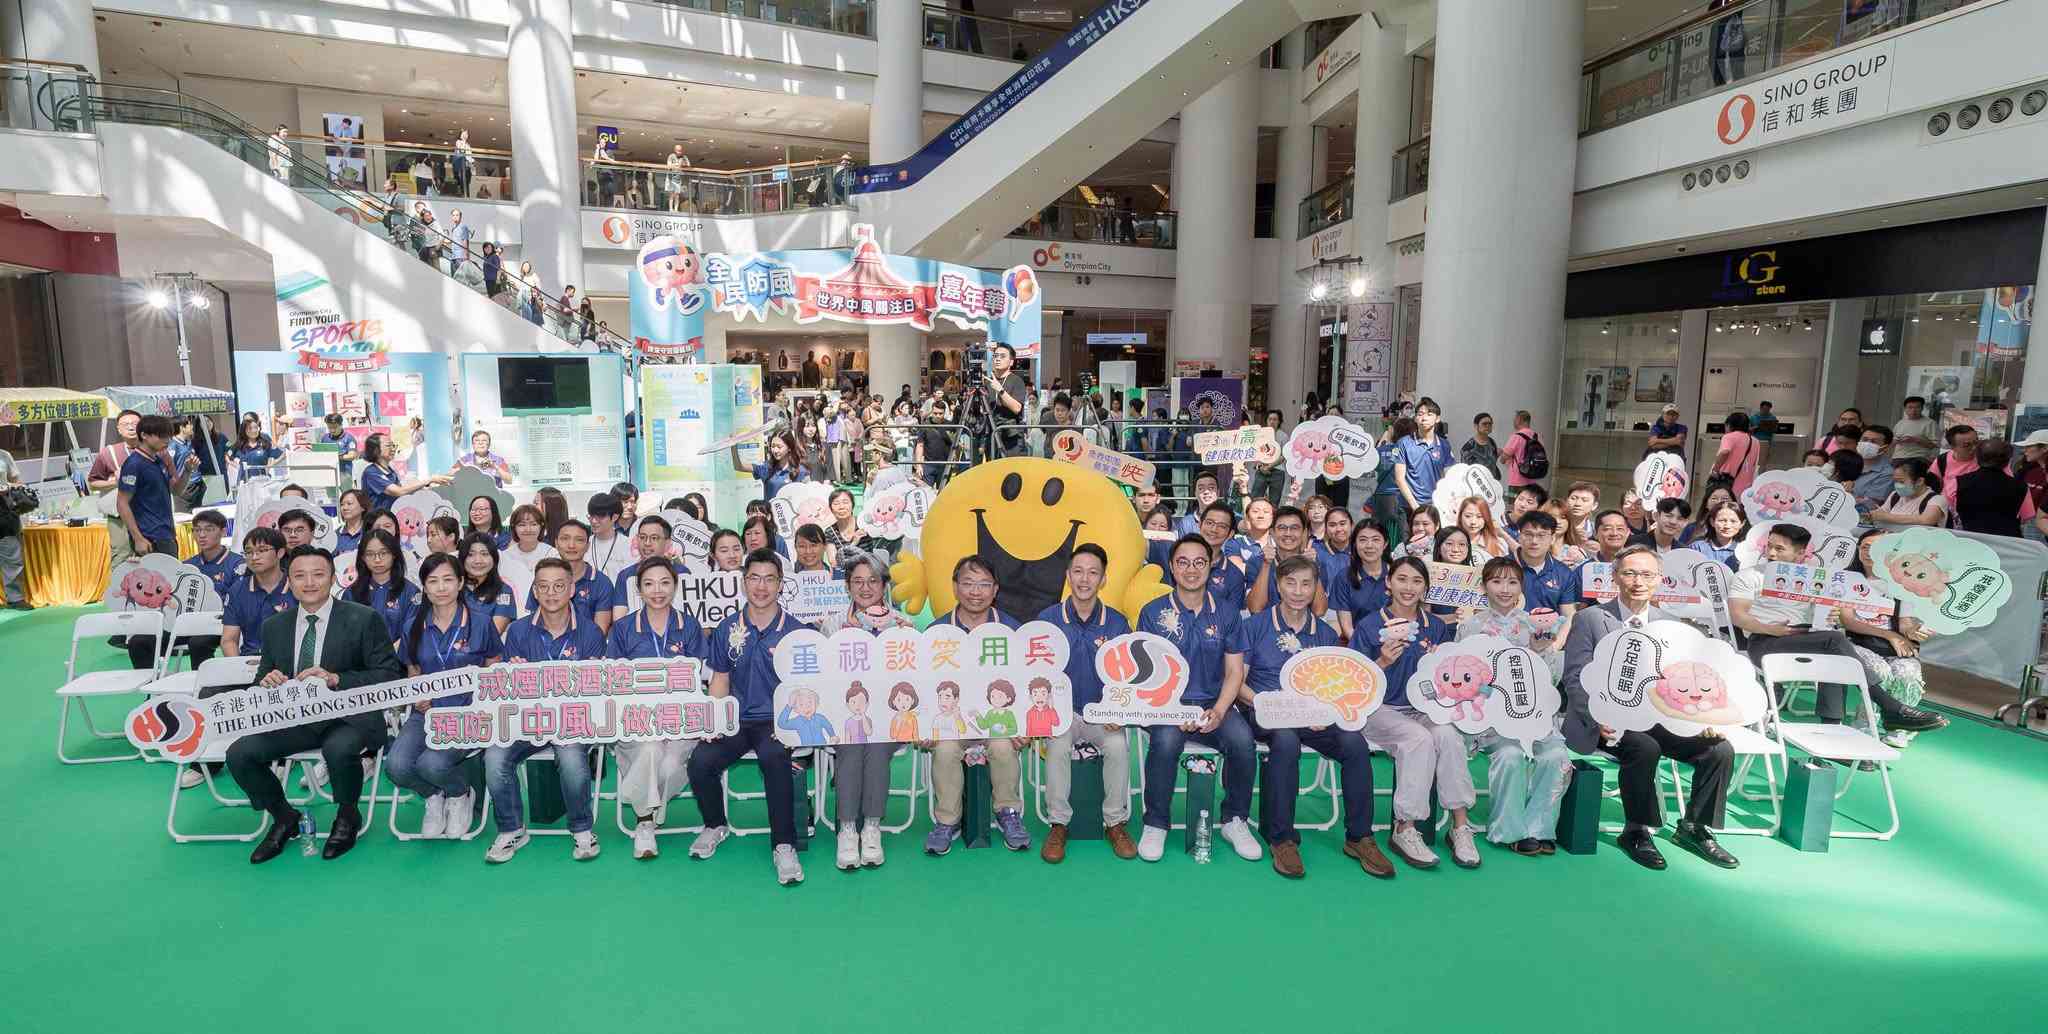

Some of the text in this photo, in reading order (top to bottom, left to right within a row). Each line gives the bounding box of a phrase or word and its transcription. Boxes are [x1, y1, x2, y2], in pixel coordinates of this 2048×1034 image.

[1764, 55, 1887, 105] SINO GROUP
[1762, 87, 1858, 133] 信和集團
[599, 132, 618, 144] GU
[634, 219, 704, 233] SINO GROUP
[1064, 261, 1112, 272] Olympian City
[816, 291, 916, 313] 世界中風關注日
[940, 274, 1006, 315] 嘉年華
[290, 313, 341, 327] FIND YOUR
[290, 320, 384, 350] SPORTS
[18, 400, 102, 420] 多方位健康檢查
[1205, 447, 1257, 462] 健康飲食
[1121, 463, 1145, 483] 快
[802, 575, 826, 585] HKU
[1776, 564, 1846, 583] 談笑用兵
[681, 575, 738, 601] HKU
[802, 584, 848, 596] STROK
[1954, 574, 1996, 613] 戒煙限酒
[682, 599, 739, 624] Med
[789, 634, 1057, 675] 重視談笑用兵
[1617, 637, 1643, 694] 充足睡眠
[477, 661, 692, 701] 戒煙限酒控三高
[1509, 654, 1529, 707] 控制血壓
[211, 684, 320, 717] 香港中風學會
[213, 673, 475, 736] THE HONG KONG STROKE SOCIETY
[1110, 688, 1132, 707] 25
[1089, 709, 1199, 720] Standing with you since 2001
